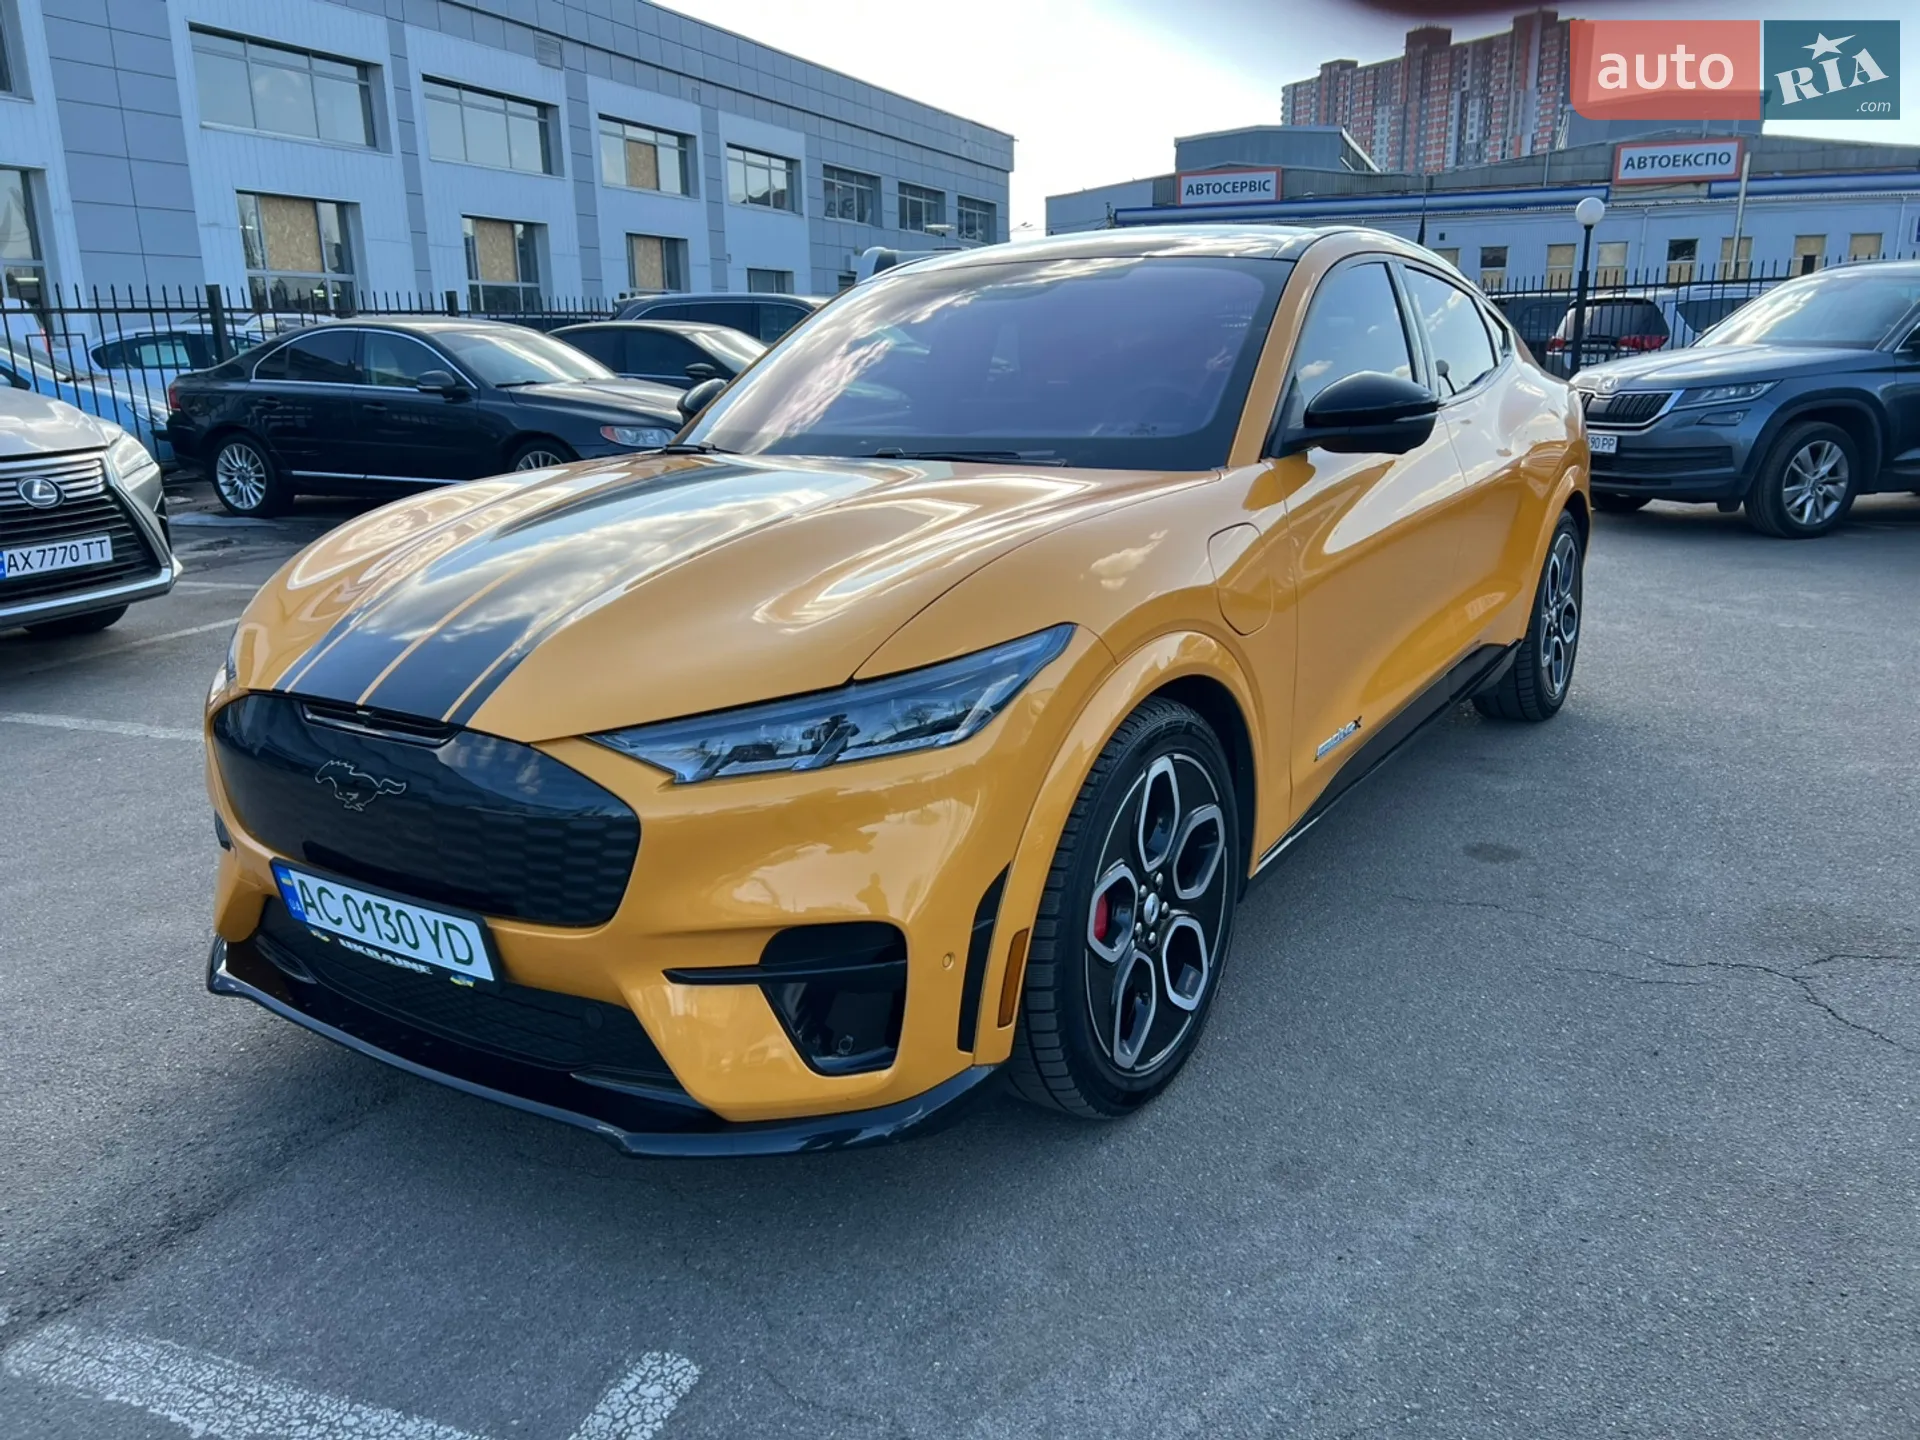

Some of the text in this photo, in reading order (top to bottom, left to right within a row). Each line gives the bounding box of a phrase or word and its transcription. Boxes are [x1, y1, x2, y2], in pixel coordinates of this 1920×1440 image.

[1624, 151, 1732, 171] АВТОЕКСПО
[1185, 179, 1271, 196] АВТОСЕРВІС
[1588, 436, 1600, 449] 90
[6, 539, 107, 573] AX 7770 TT
[297, 878, 475, 967] AC 0130 YD
